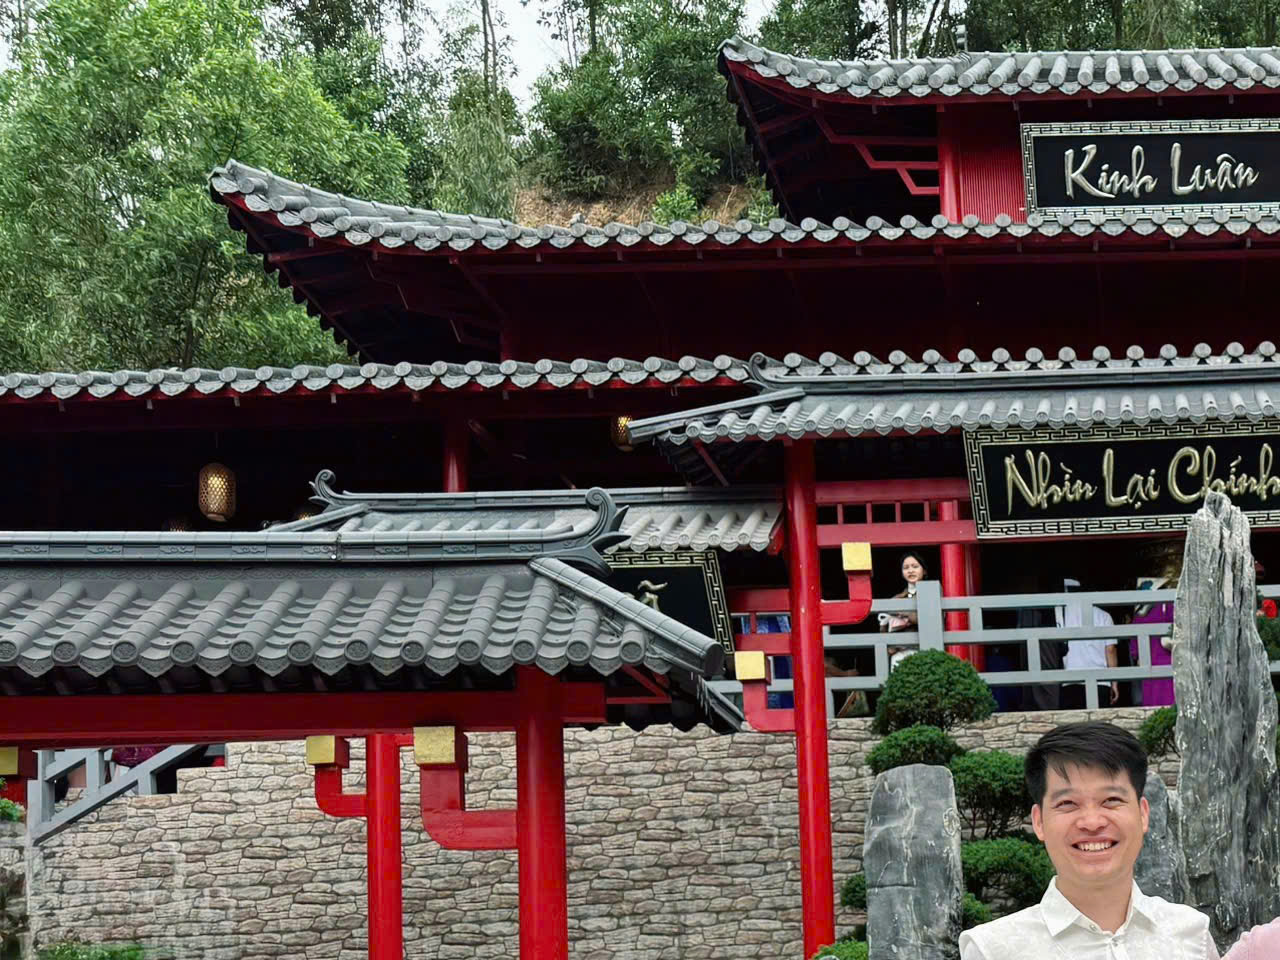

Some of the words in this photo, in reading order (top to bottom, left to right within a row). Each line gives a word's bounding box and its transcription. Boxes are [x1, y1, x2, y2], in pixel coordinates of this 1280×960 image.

[1064, 144, 1158, 199] Kinh
[1170, 142, 1260, 195] Luân
[1004, 449, 1098, 515] Nhìn
[1103, 447, 1161, 509] Lại
